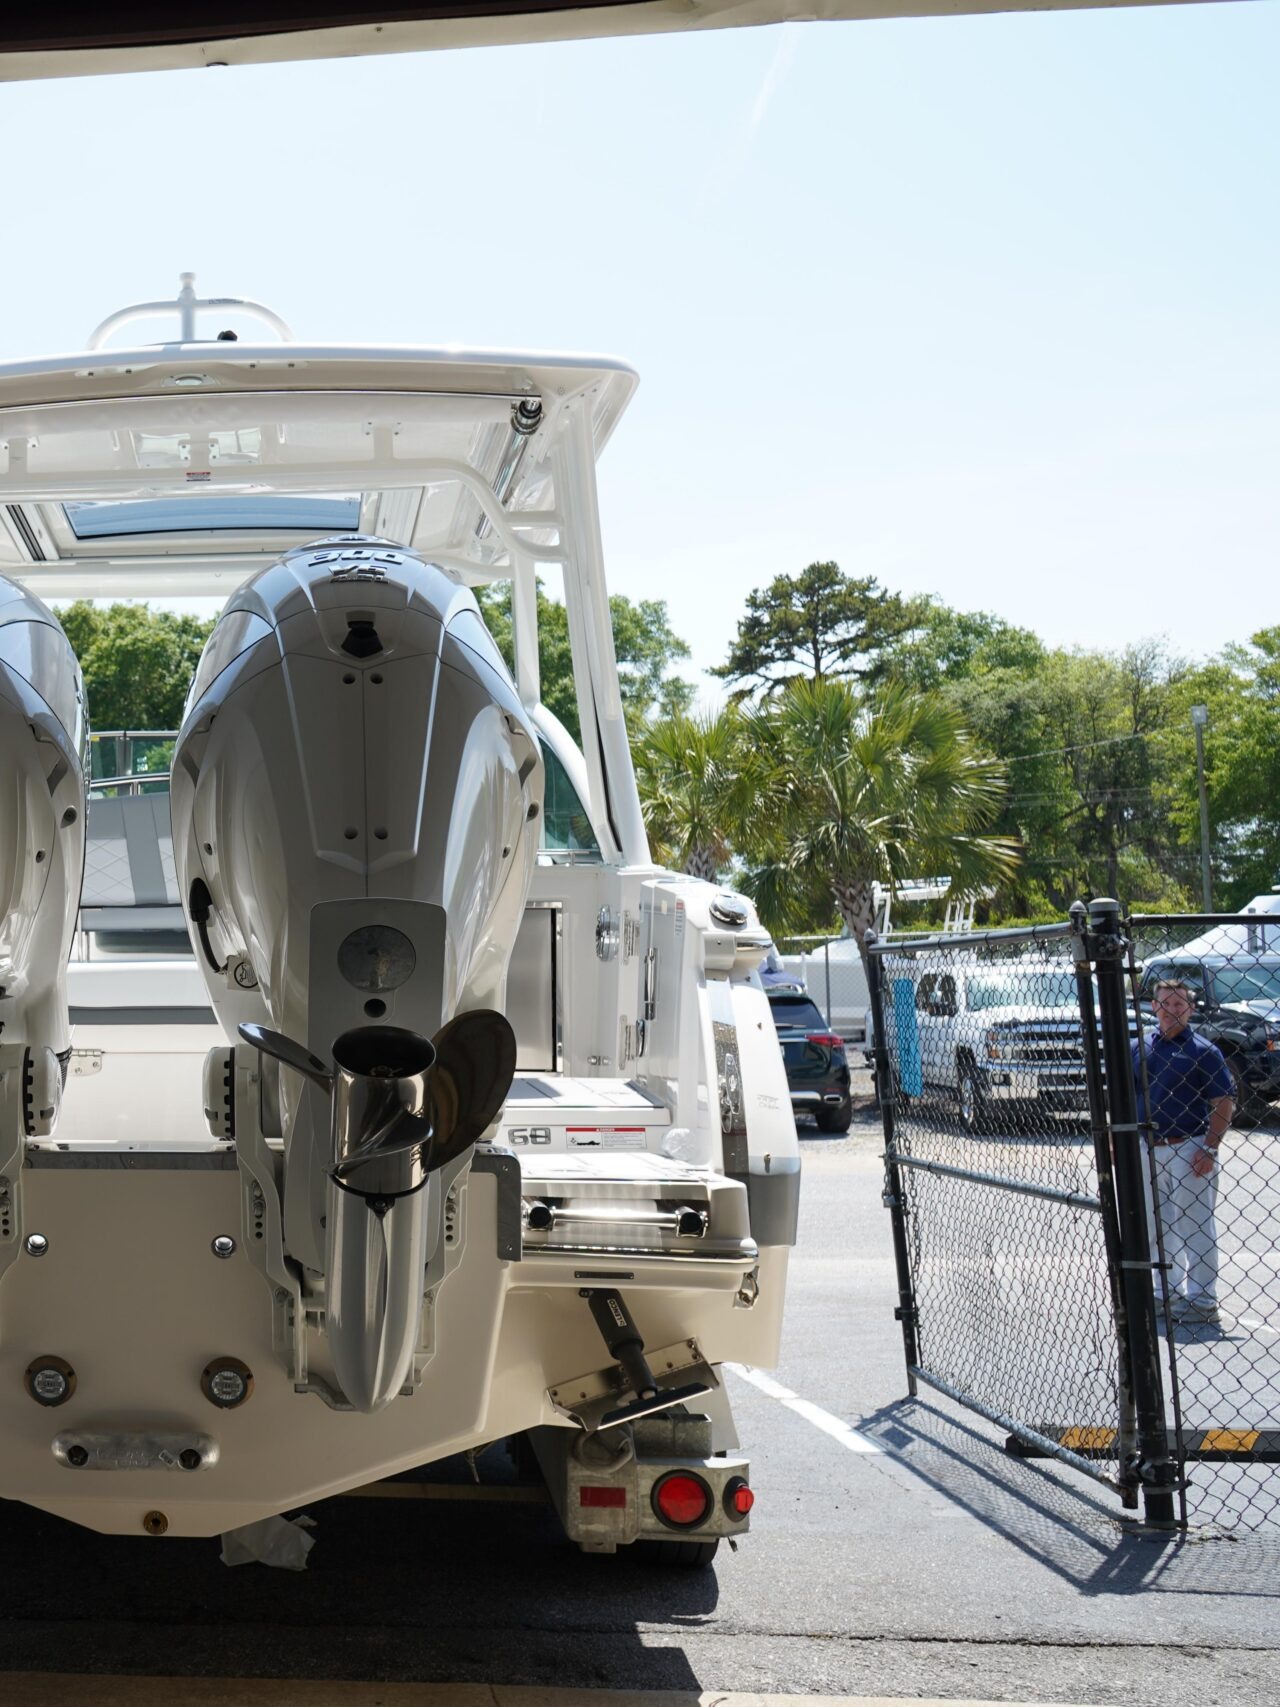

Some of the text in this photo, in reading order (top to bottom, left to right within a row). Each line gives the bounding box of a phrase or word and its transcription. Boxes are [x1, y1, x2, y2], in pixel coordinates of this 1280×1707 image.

[308, 548, 404, 566] 300
[328, 563, 387, 577] V6
[609, 1300, 623, 1321] LENCO
